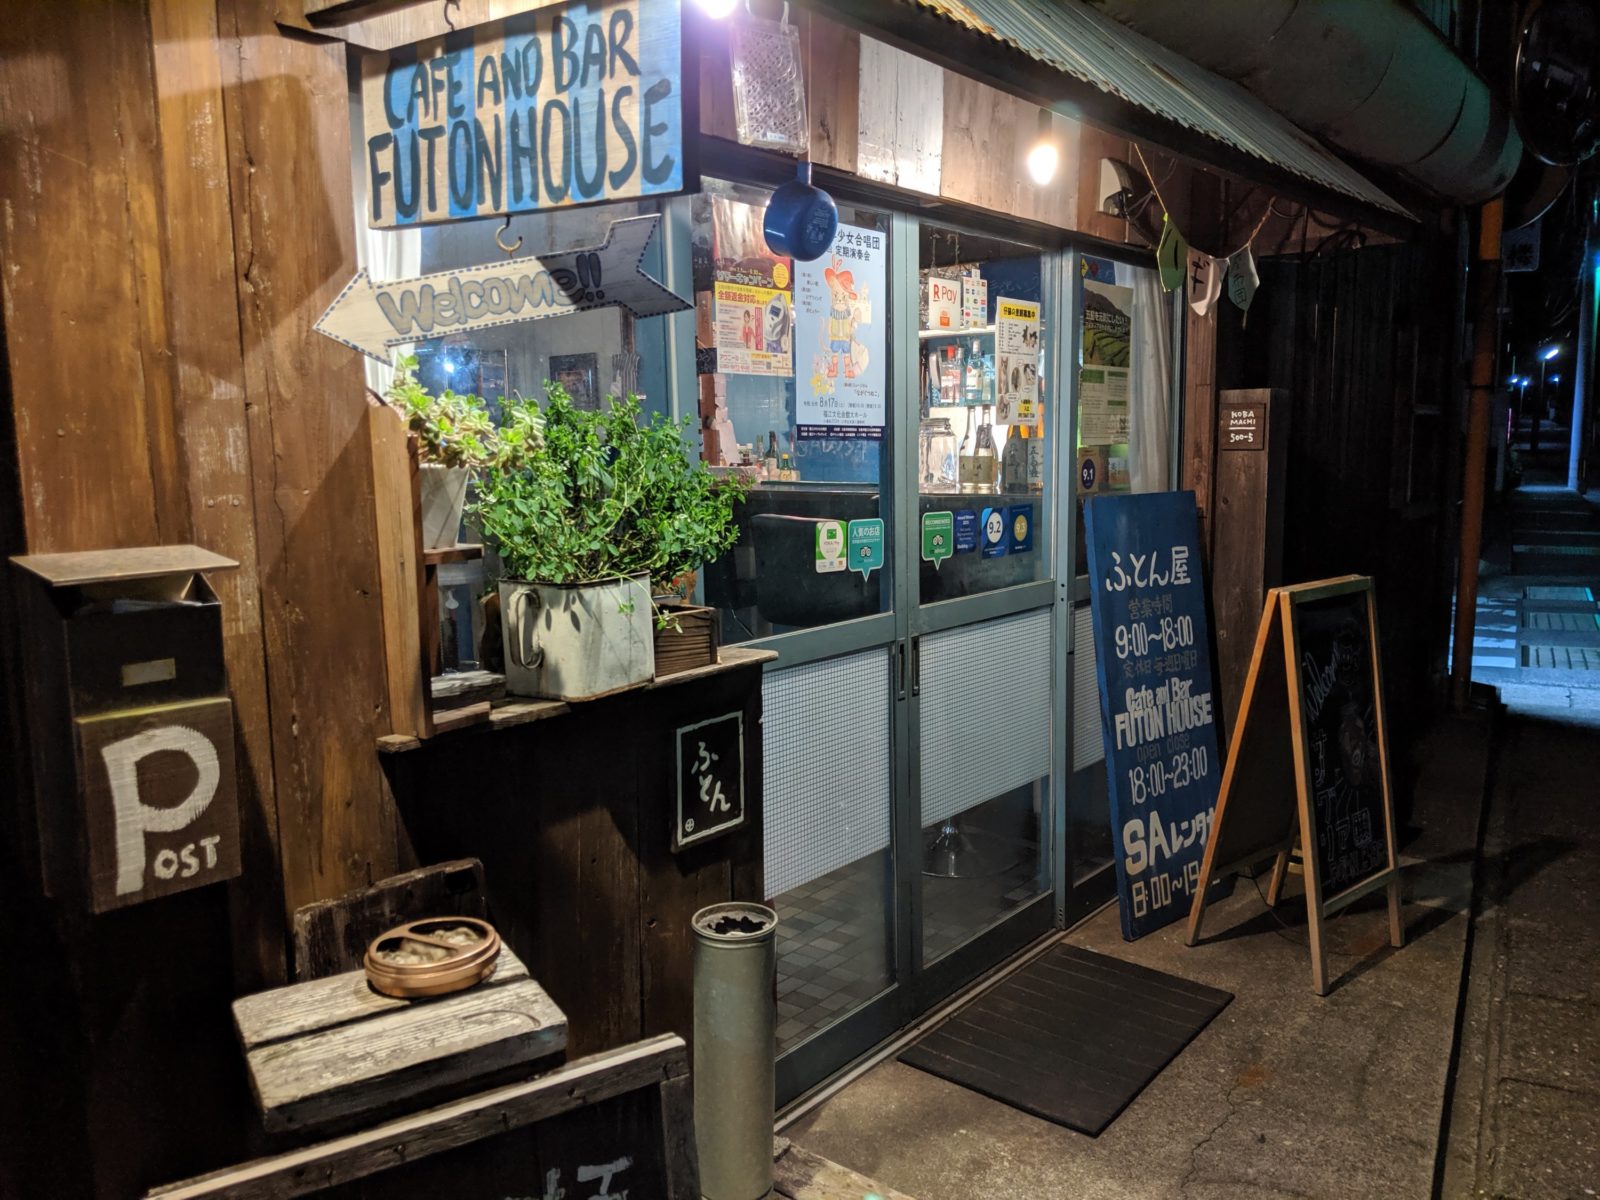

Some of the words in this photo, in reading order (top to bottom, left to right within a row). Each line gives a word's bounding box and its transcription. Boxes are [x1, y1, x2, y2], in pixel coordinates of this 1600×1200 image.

[383, 53, 466, 129] CAFE
[477, 36, 544, 108] AND
[551, 8, 642, 94] BAR
[367, 114, 502, 221] FUTON
[509, 78, 676, 204] HOUSE
[836, 229, 880, 250] 少女合唱団
[1083, 468, 1094, 481] 9.1
[989, 521, 1001, 535] 9.2
[1105, 545, 1192, 592] ふとん屋
[1171, 677, 1193, 705] Bar
[1115, 707, 1165, 750] FUTON
[1167, 692, 1213, 739] HOUSE
[691, 741, 731, 812] ふとん
